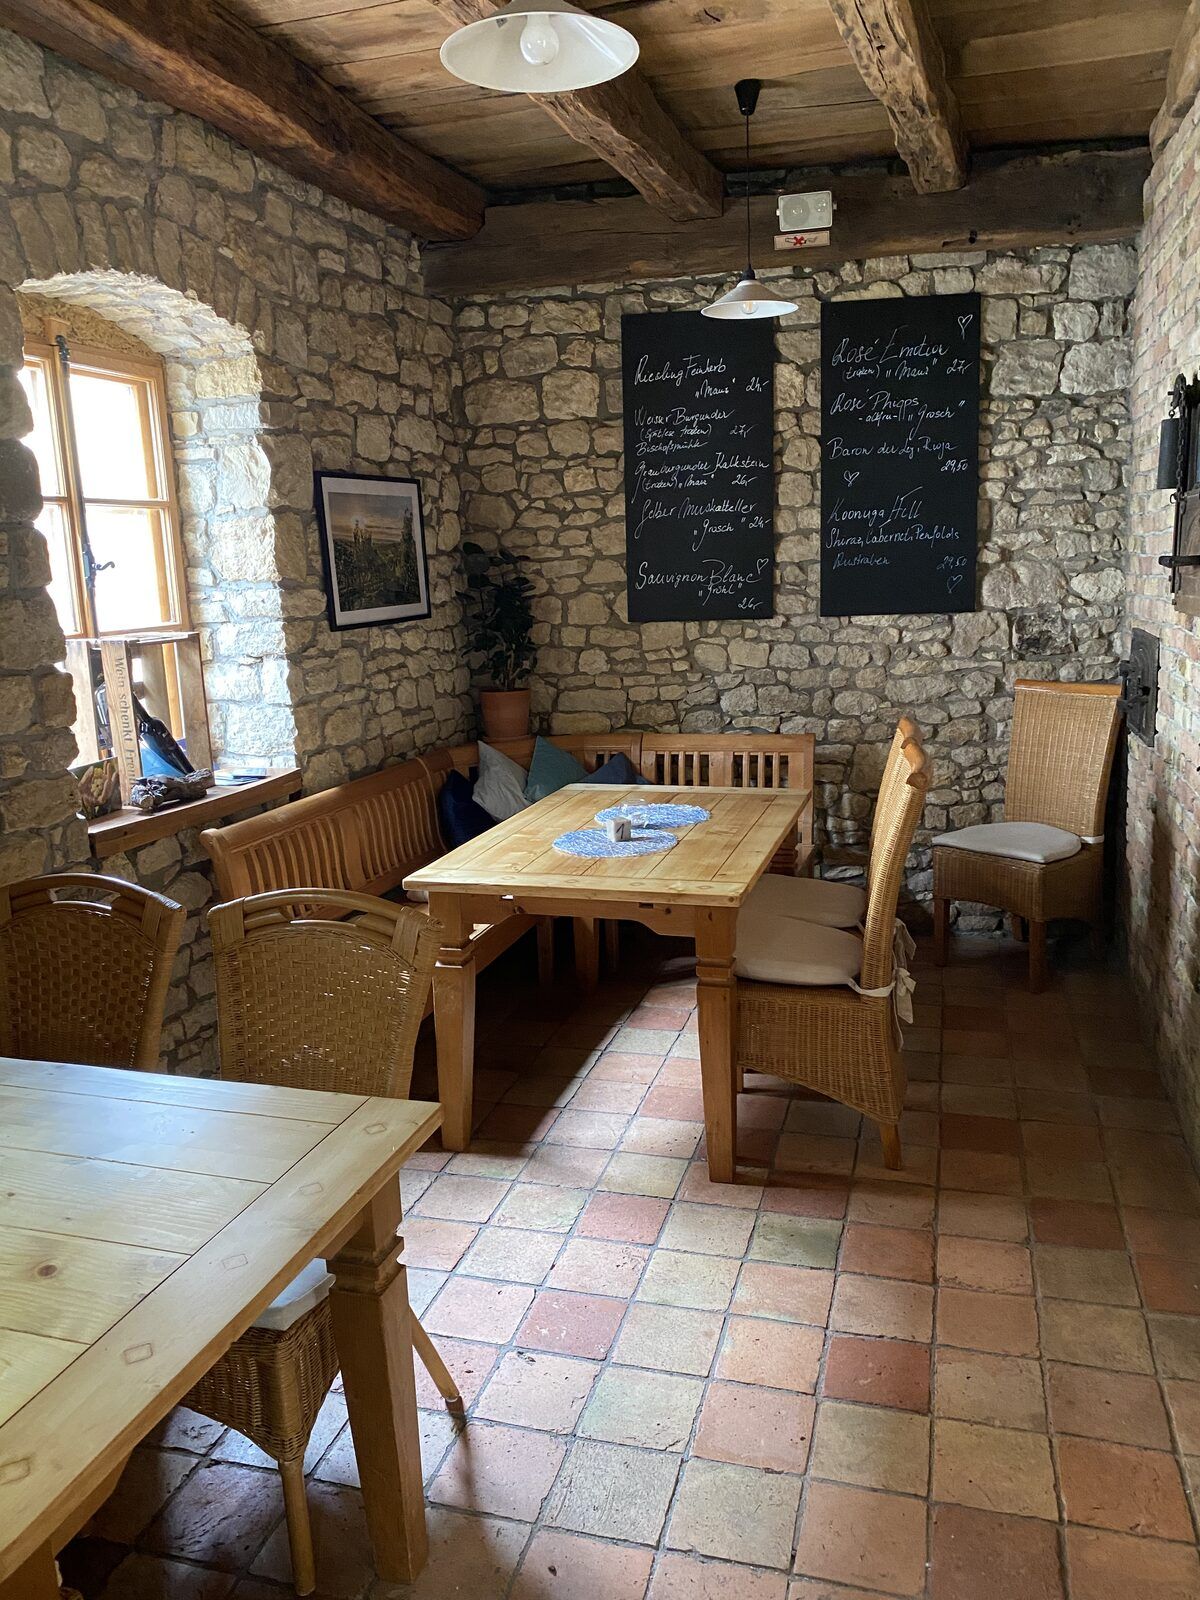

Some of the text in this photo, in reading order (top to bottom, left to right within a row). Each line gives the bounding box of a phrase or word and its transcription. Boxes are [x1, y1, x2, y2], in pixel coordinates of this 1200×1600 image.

[832, 336, 880, 367] Rosé
[634, 353, 727, 387] Riesling Feinherb
[670, 406, 735, 428] Burgunder
[827, 436, 874, 460] Baron
[635, 558, 763, 590] Sauvignon Blanc
[114, 656, 125, 690] Wein
[120, 693, 133, 742] schenkt
[615, 823, 625, 840] 1
